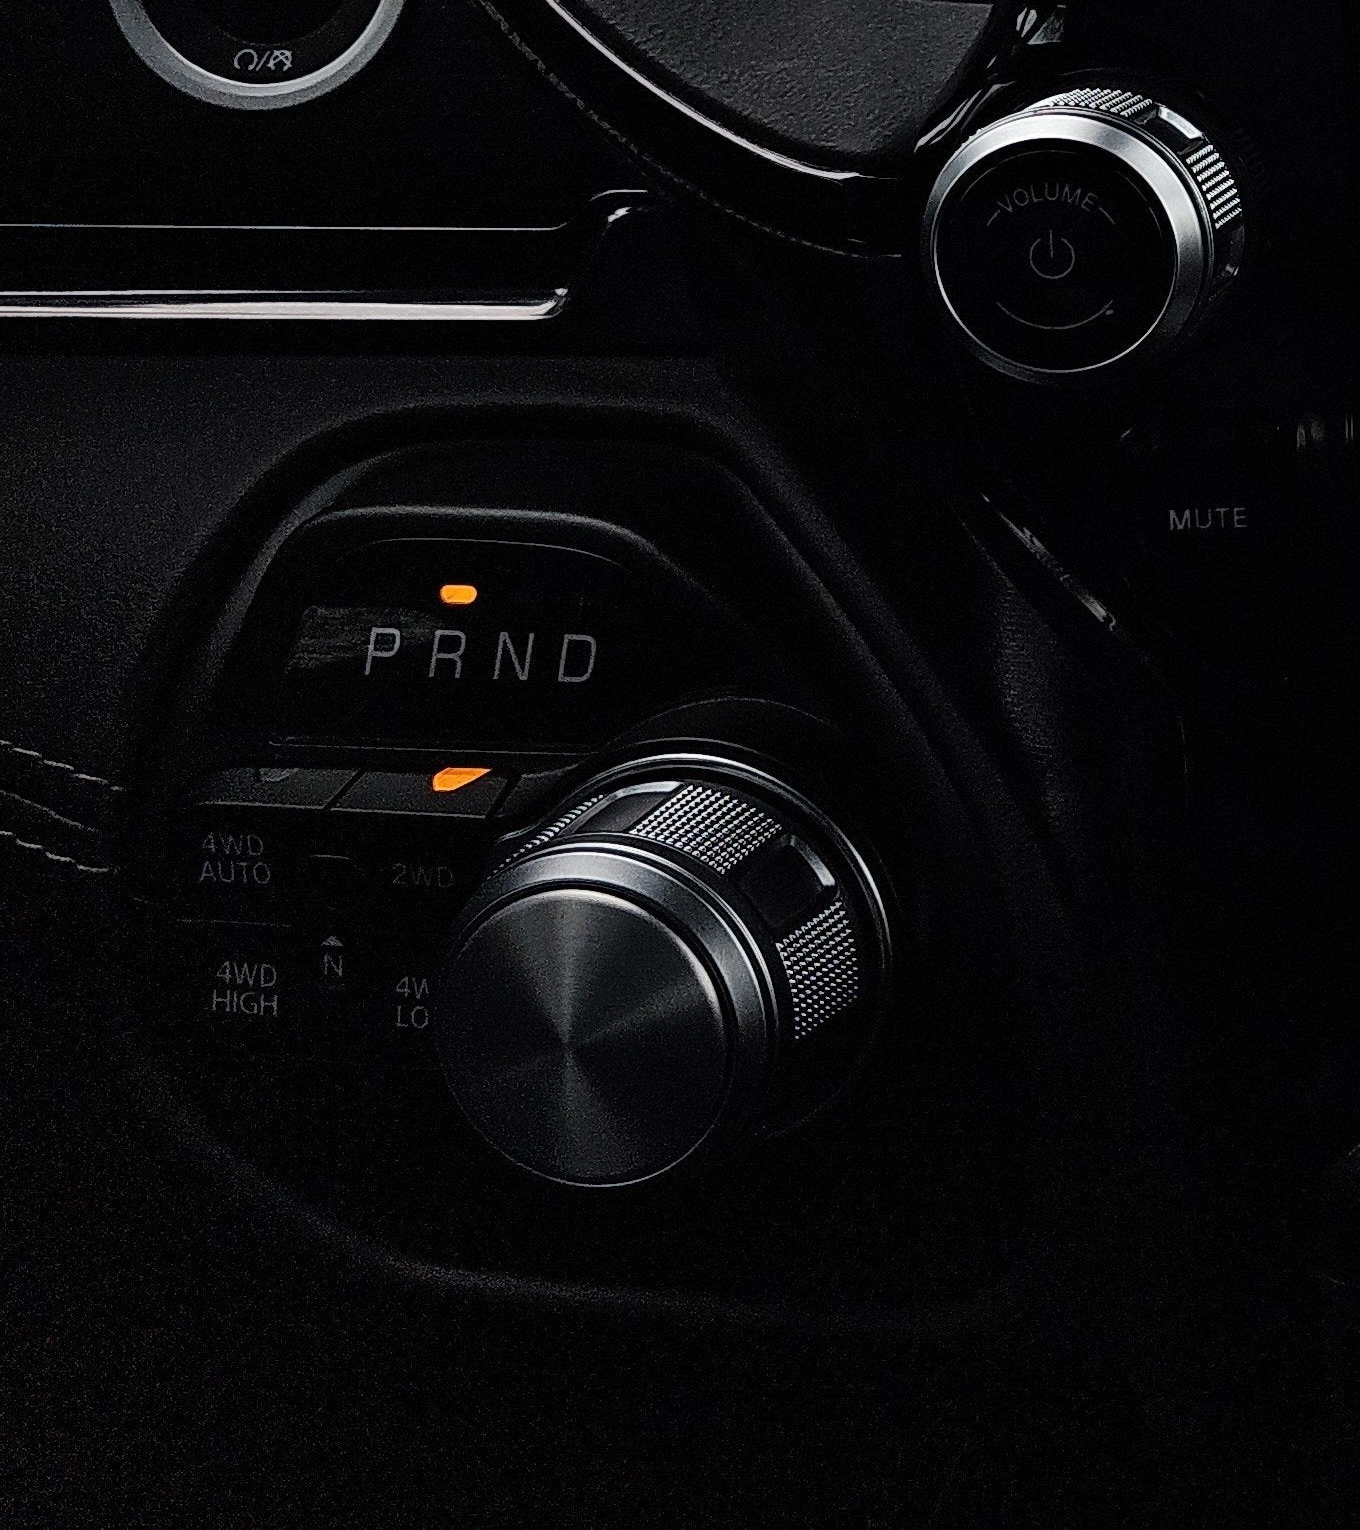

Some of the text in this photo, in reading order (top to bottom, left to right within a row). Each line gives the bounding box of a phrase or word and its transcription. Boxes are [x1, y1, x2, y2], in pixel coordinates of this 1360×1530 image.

[997, 183, 1102, 215] VOLUME
[1167, 506, 1250, 532] MUTE
[200, 832, 264, 858] 4WD
[198, 860, 272, 886] AUTO
[391, 861, 455, 889] 2WD
[215, 962, 278, 989] 4WD
[322, 952, 344, 977] N
[211, 988, 280, 1018] HIGH
